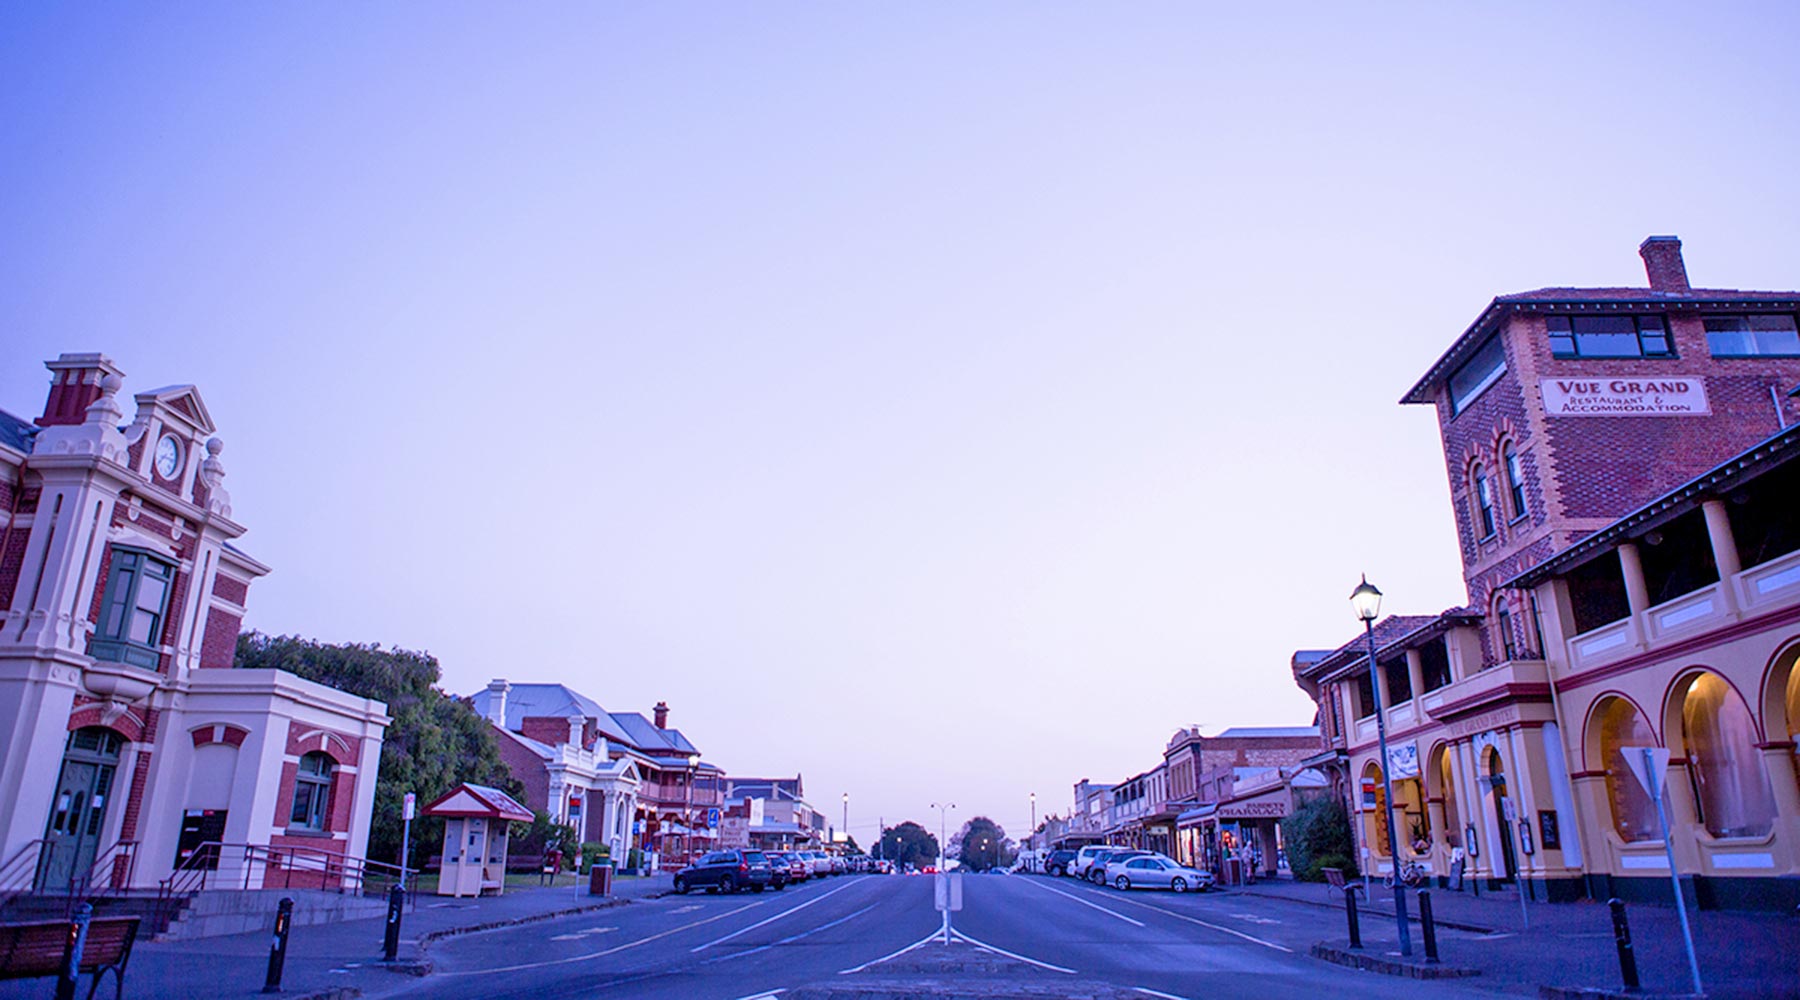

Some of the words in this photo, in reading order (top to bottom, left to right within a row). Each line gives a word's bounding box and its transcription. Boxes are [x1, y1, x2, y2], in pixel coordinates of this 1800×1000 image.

[1556, 381, 1601, 394] VUE
[1609, 381, 1690, 394] GRAND
[1569, 396, 1643, 405] RESTAURANT
[1561, 403, 1692, 412] ACCOMMODATION
[1219, 808, 1285, 816] PHARMACY
